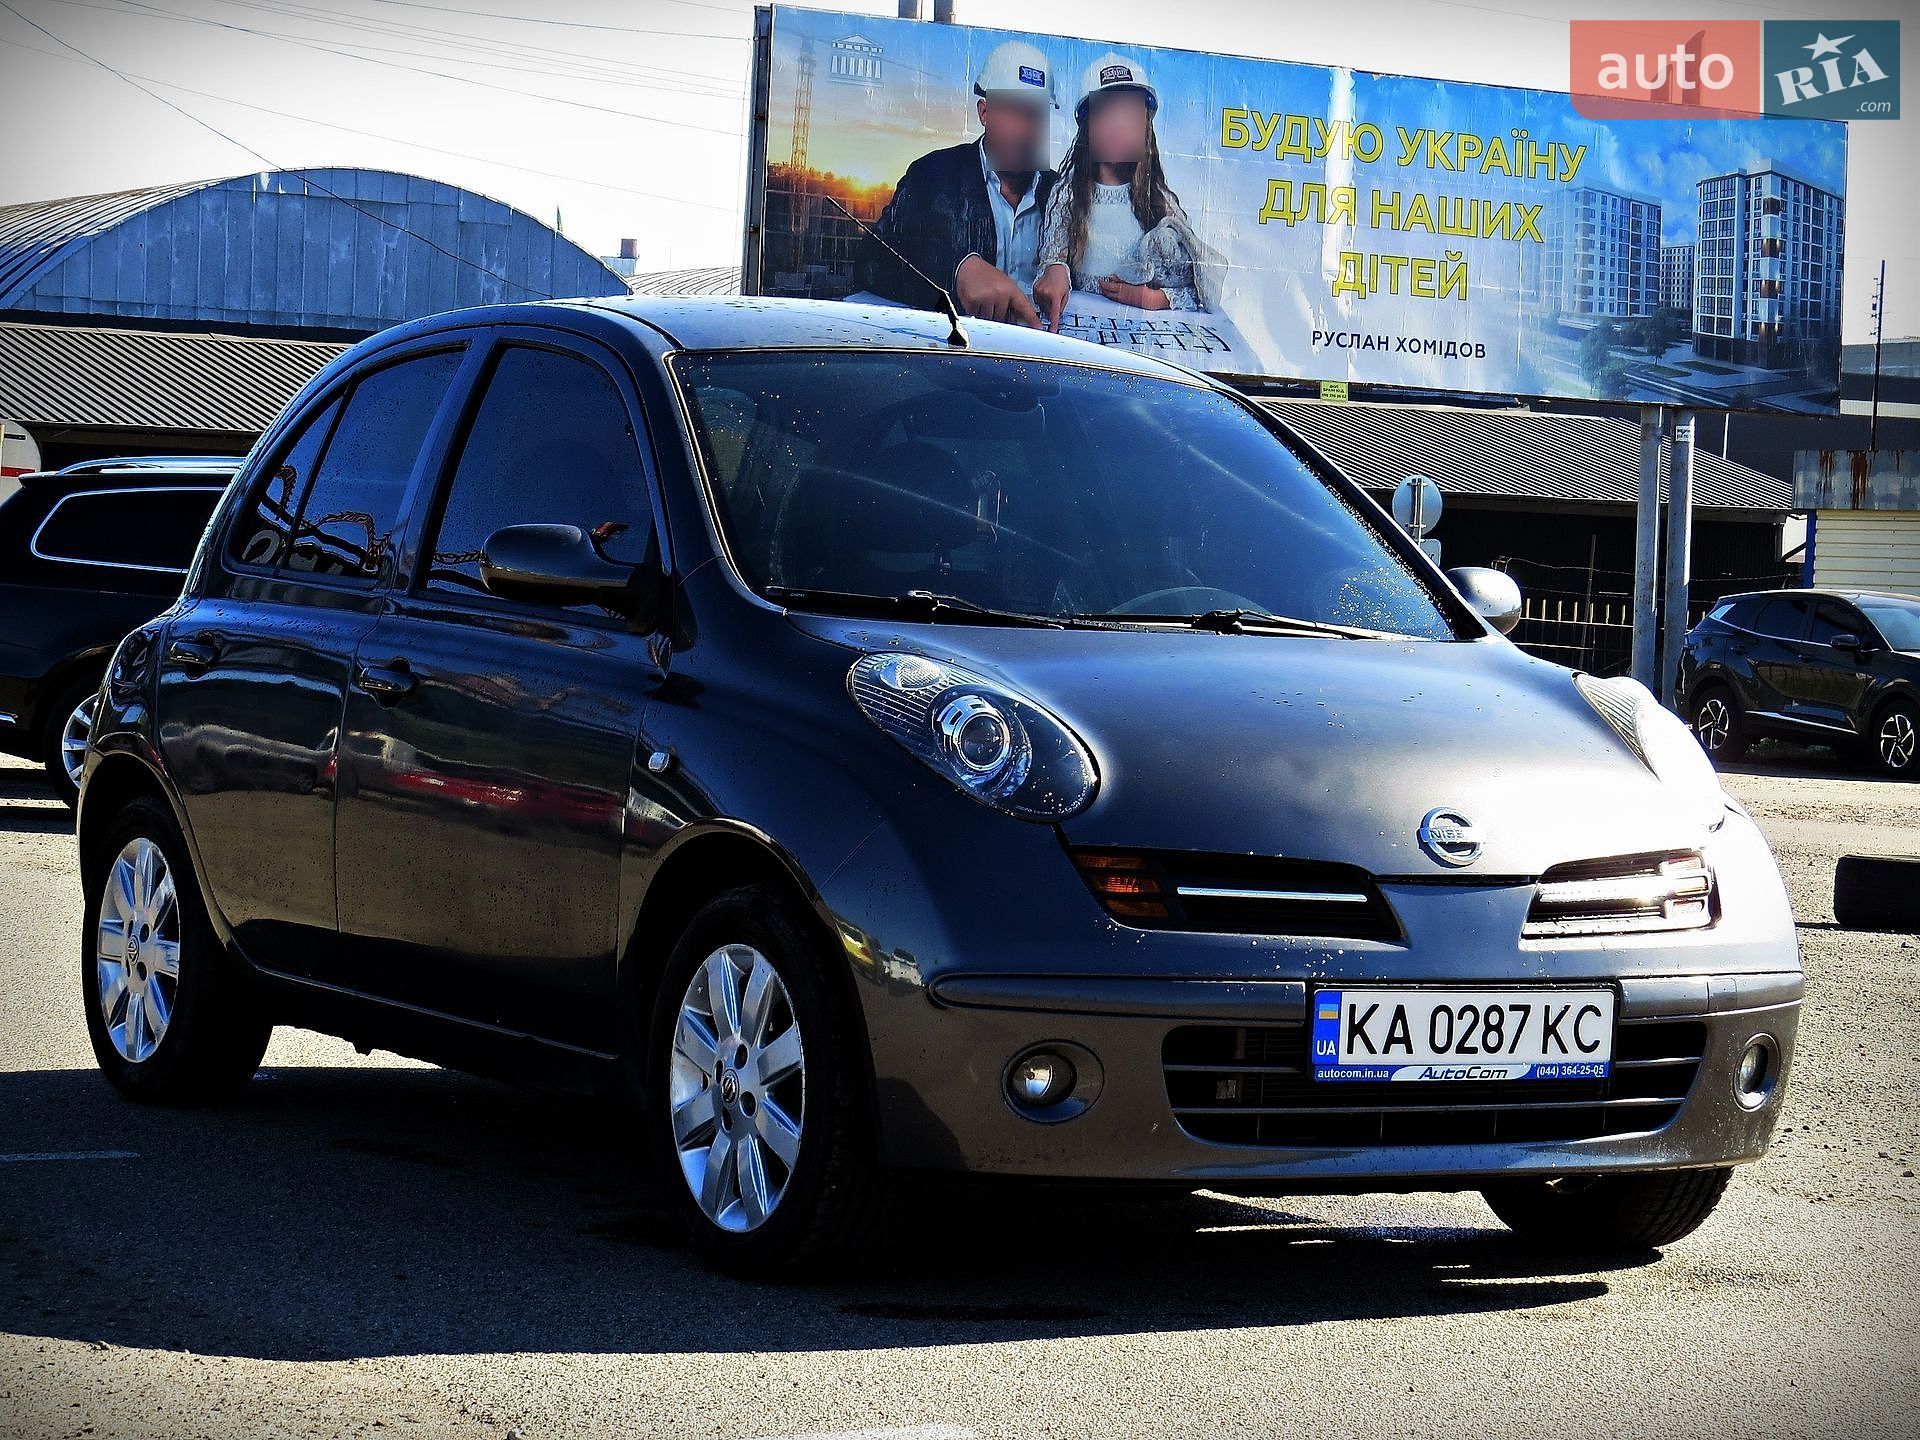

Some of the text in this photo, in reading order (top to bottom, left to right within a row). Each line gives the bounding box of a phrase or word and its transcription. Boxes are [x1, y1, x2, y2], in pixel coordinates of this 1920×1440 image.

[1220, 107, 1587, 183] БУДУЮ УКРАЇНУ
[1258, 178, 1545, 243] ДЛЯ НАШИХ
[1331, 250, 1469, 301] ДІТЕЙ
[1311, 330, 1487, 360] РУСЛАН ХОМІДОВ
[1346, 1003, 1602, 1055] KA 0287 KC
[1316, 1039, 1337, 1056] UA
[1317, 1068, 1389, 1079] autocom.in.ua
[1418, 1066, 1508, 1080] AutoCom
[1536, 1064, 1604, 1078] (044) 364-25-05
